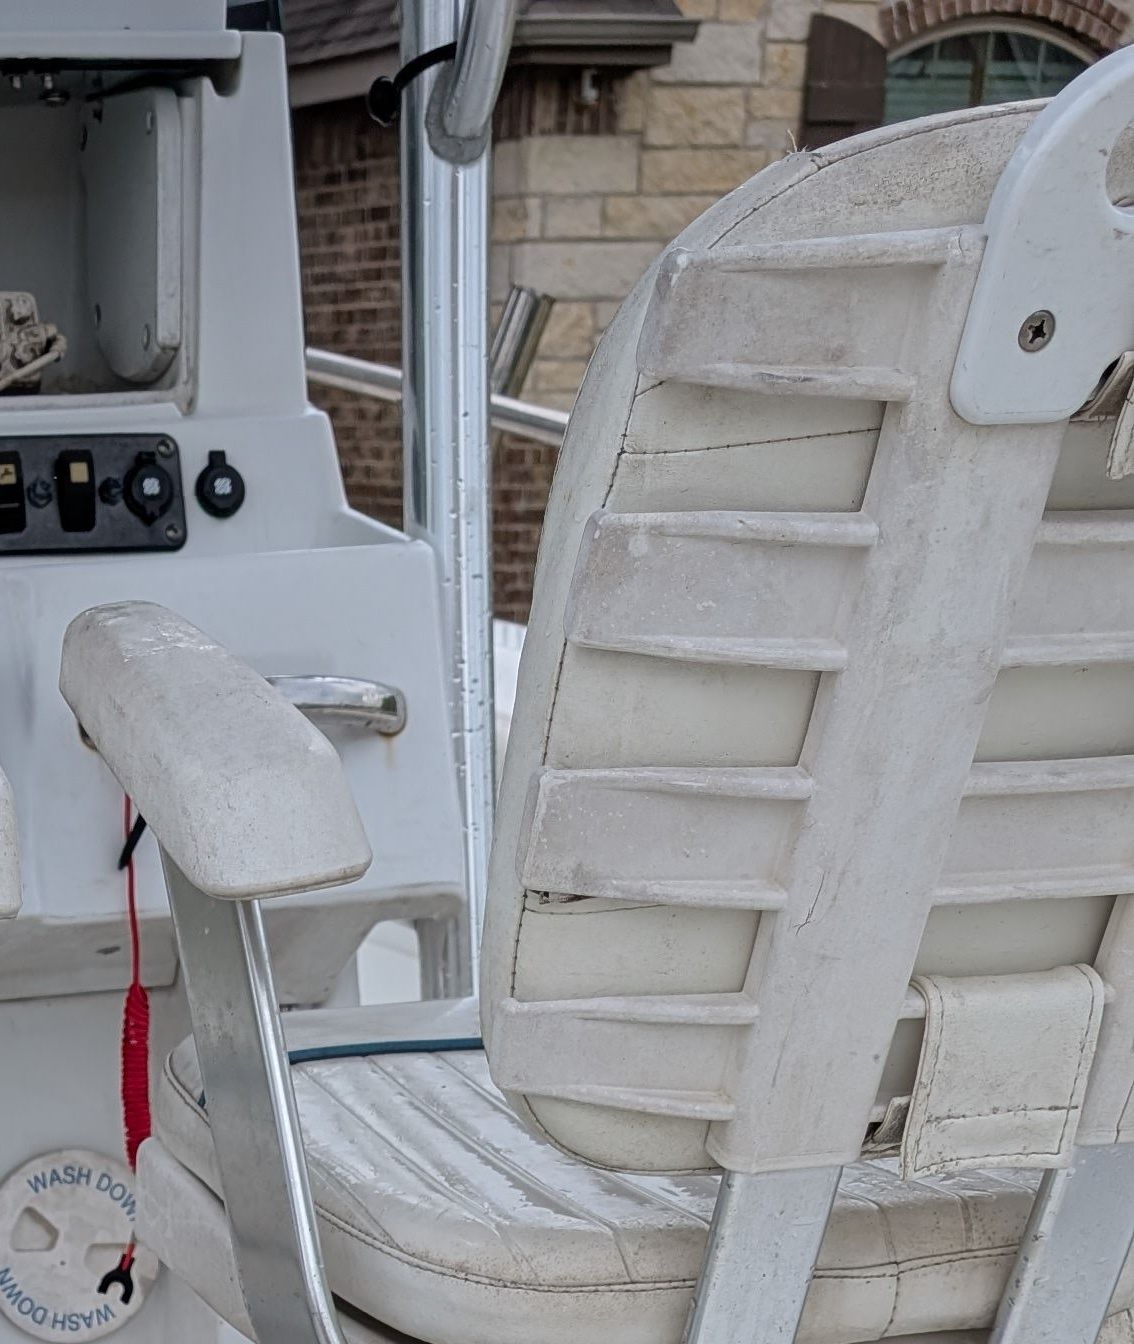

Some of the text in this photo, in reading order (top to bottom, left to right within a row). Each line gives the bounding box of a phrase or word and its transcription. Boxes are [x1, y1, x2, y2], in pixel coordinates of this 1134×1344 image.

[27, 1166, 137, 1222] WASH DOW
[51, 1304, 116, 1332] WASH
